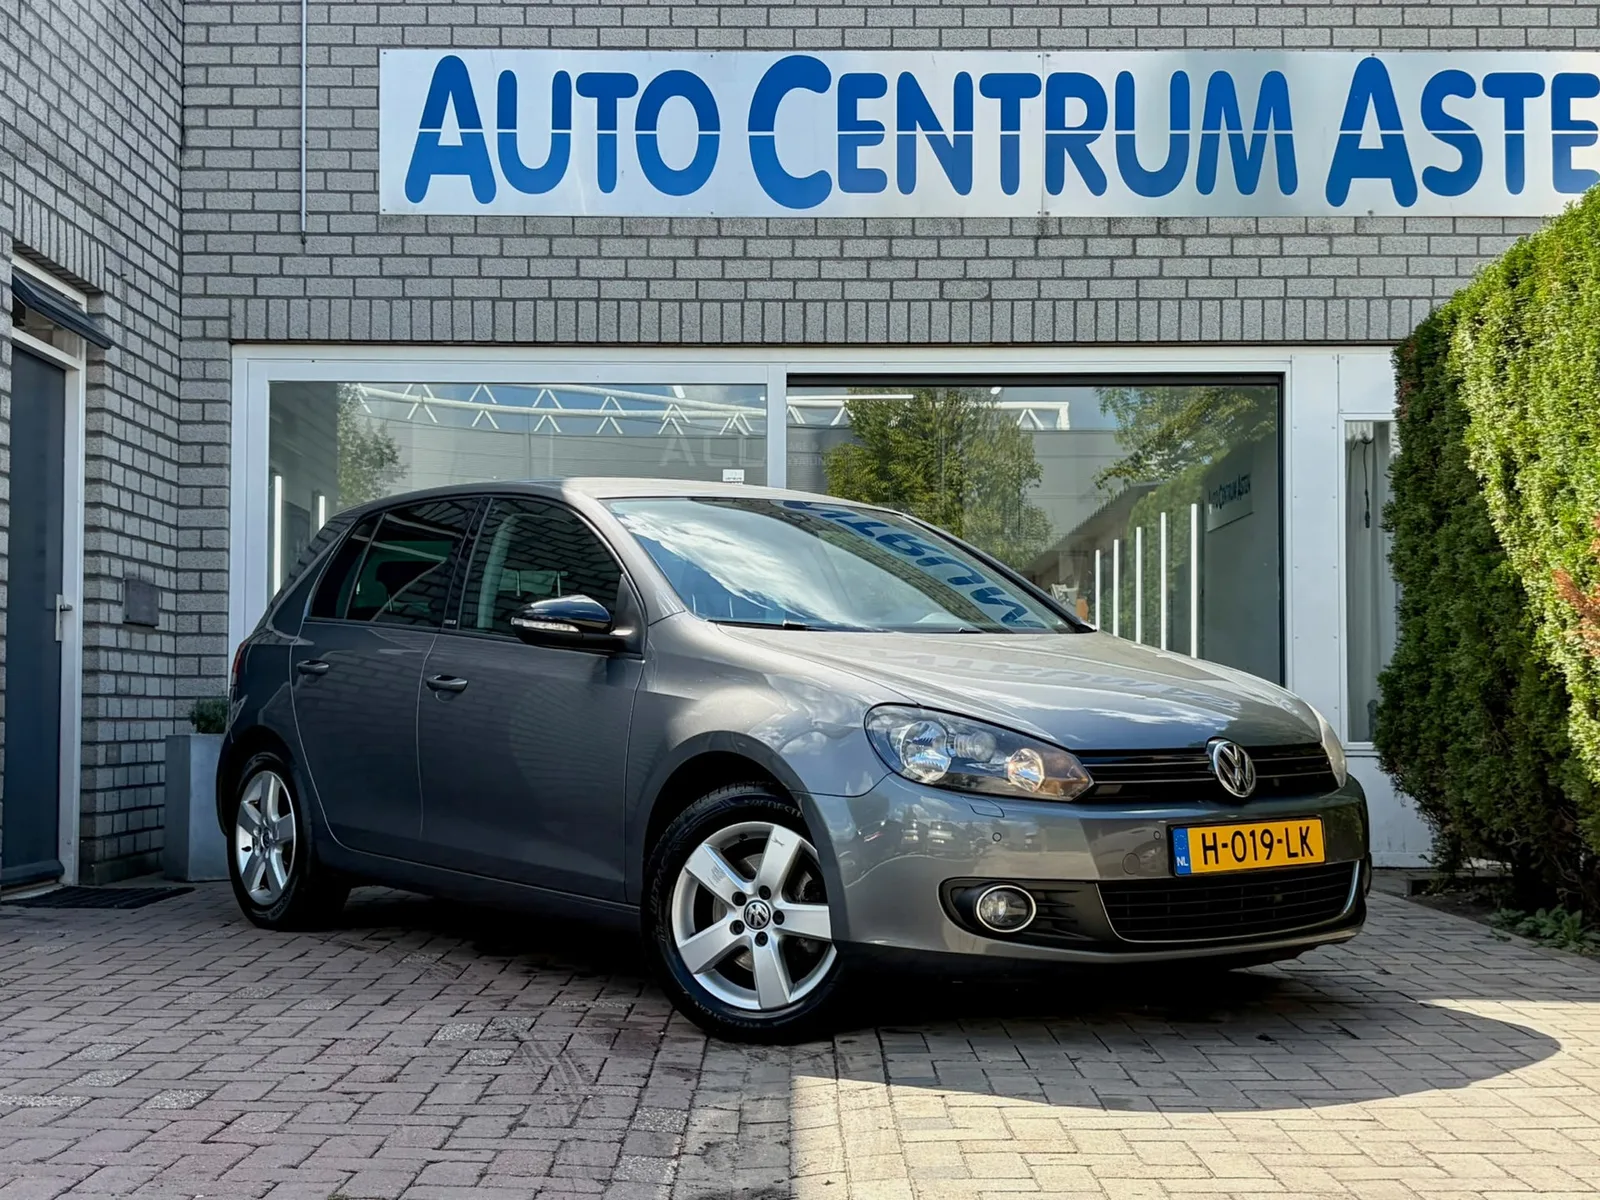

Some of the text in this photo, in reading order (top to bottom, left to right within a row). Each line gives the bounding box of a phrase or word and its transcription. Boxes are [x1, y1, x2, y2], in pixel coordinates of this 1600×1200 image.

[404, 55, 720, 205] AUTO
[748, 54, 1298, 209] CENTRUM
[1176, 856, 1189, 867] NL
[1201, 825, 1314, 866] H-019-LK
